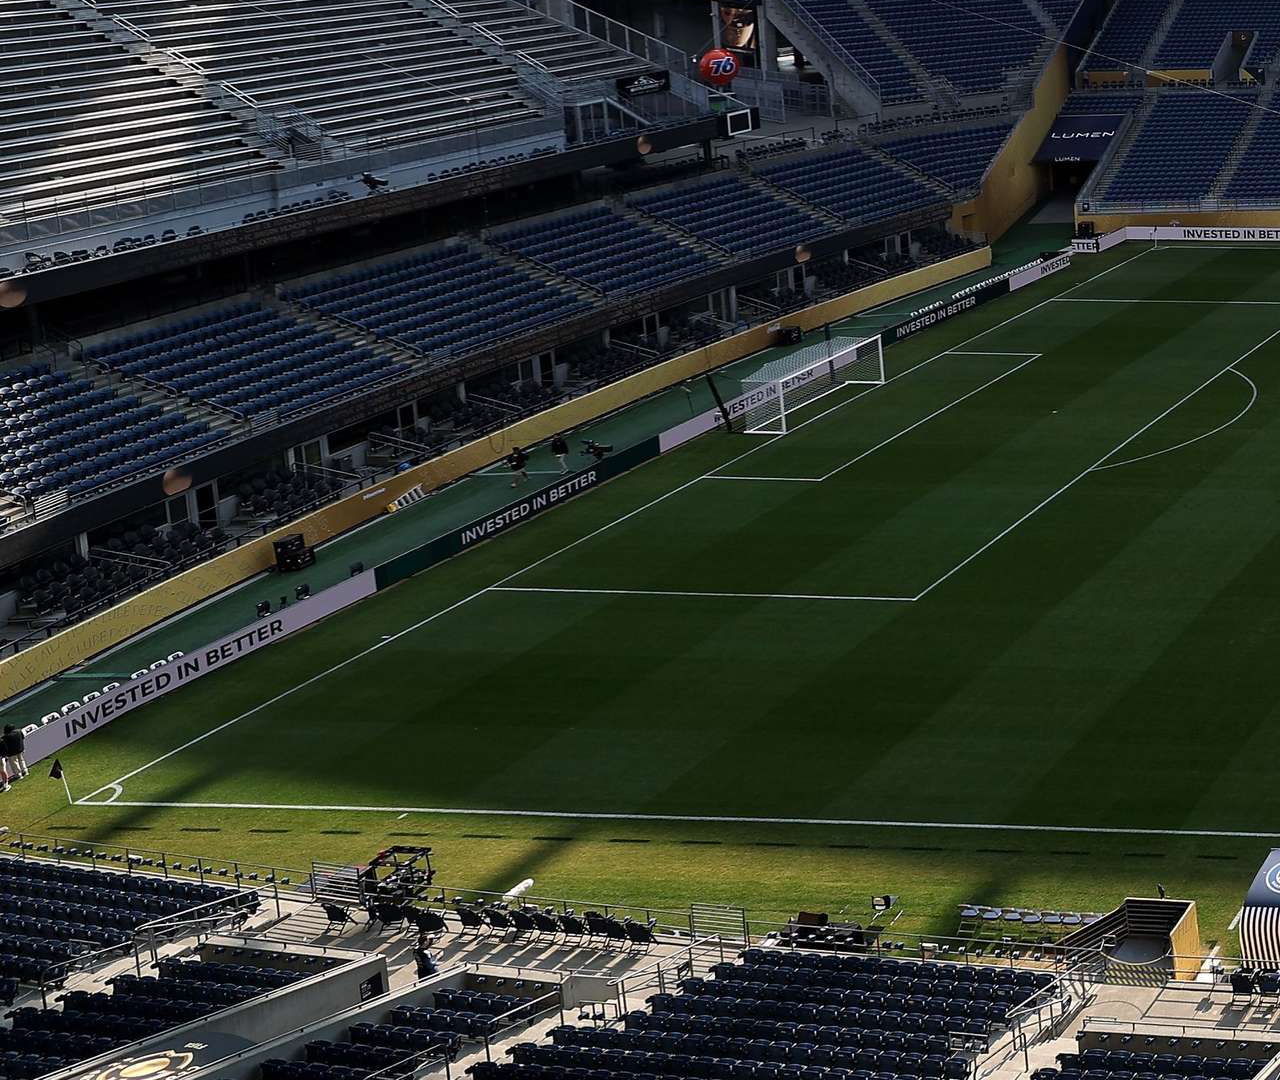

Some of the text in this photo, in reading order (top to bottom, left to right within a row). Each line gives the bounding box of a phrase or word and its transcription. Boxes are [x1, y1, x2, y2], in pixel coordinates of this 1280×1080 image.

[709, 56, 736, 77] 76
[1051, 130, 1115, 139] LUMEN
[1183, 229, 1240, 239] INVESTED
[1243, 230, 1255, 239] IN
[1040, 256, 1070, 274] INVESTED
[896, 296, 976, 338] INVESTED IN BETTER
[461, 471, 596, 545] INVESTED IN BETTER
[65, 671, 171, 738] INVESTED
[177, 658, 200, 680] IN
[206, 619, 284, 667] BETTER
